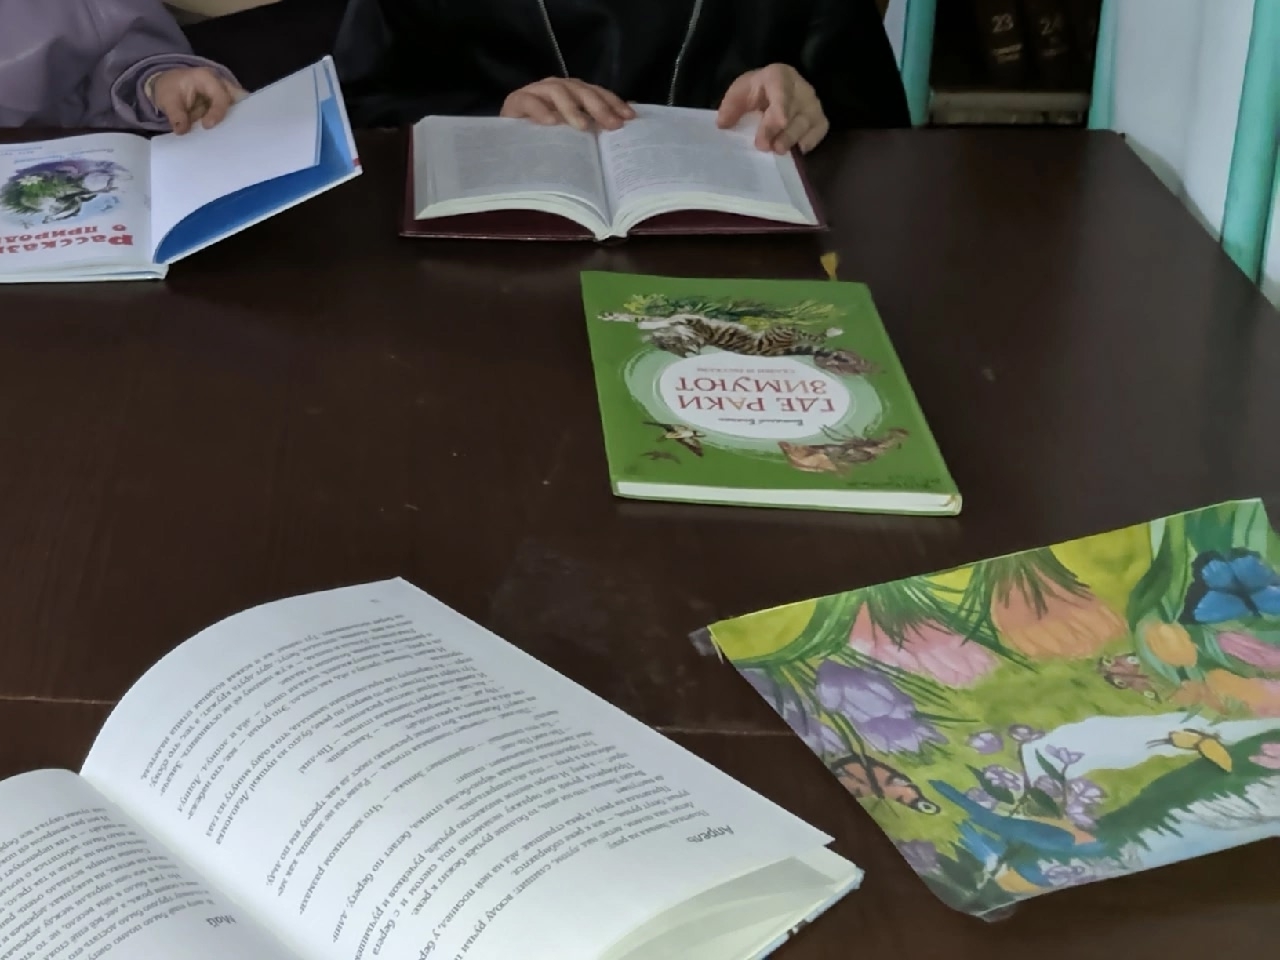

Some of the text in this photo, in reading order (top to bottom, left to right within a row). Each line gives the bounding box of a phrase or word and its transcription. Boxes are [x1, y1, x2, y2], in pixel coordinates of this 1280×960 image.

[991, 13, 1014, 33] 23
[675, 376, 827, 395] ЗИМУЮТ
[677, 394, 835, 413] ГДЕ РАКИ
[141, 710, 193, 779] птица налетела,
[161, 713, 222, 794] остановить. Закача-
[168, 742, 181, 758] что
[150, 758, 169, 786] сбоку,
[178, 739, 228, 812] лопнул. Лопнул
[216, 758, 277, 844] пушки! Ледоломка
[346, 778, 371, 798] Разве
[206, 769, 251, 836] минуту из глаз
[300, 800, 326, 830] тресну
[324, 809, 335, 821] не
[334, 798, 347, 810] ты
[289, 830, 301, 845] им
[296, 821, 325, 856] знаешь,
[464, 833, 494, 858] ручьёв
[280, 845, 290, 860] по
[300, 804, 383, 914] Что хвостиком размахи-
[285, 859, 298, 876] как
[389, 854, 426, 897] ручейков
[438, 858, 467, 885] бежит
[475, 872, 493, 889] ней
[492, 863, 504, 873] на
[333, 831, 412, 942] бегает по берегу, длин-
[373, 845, 456, 955] под снегом и с берега
[411, 890, 432, 915] реке.
[438, 889, 475, 928] посинел,
[485, 894, 513, 920] всюду
[68, 922, 116, 960] достать его
[113, 924, 142, 944] полно
[461, 920, 486, 952] ручьи
